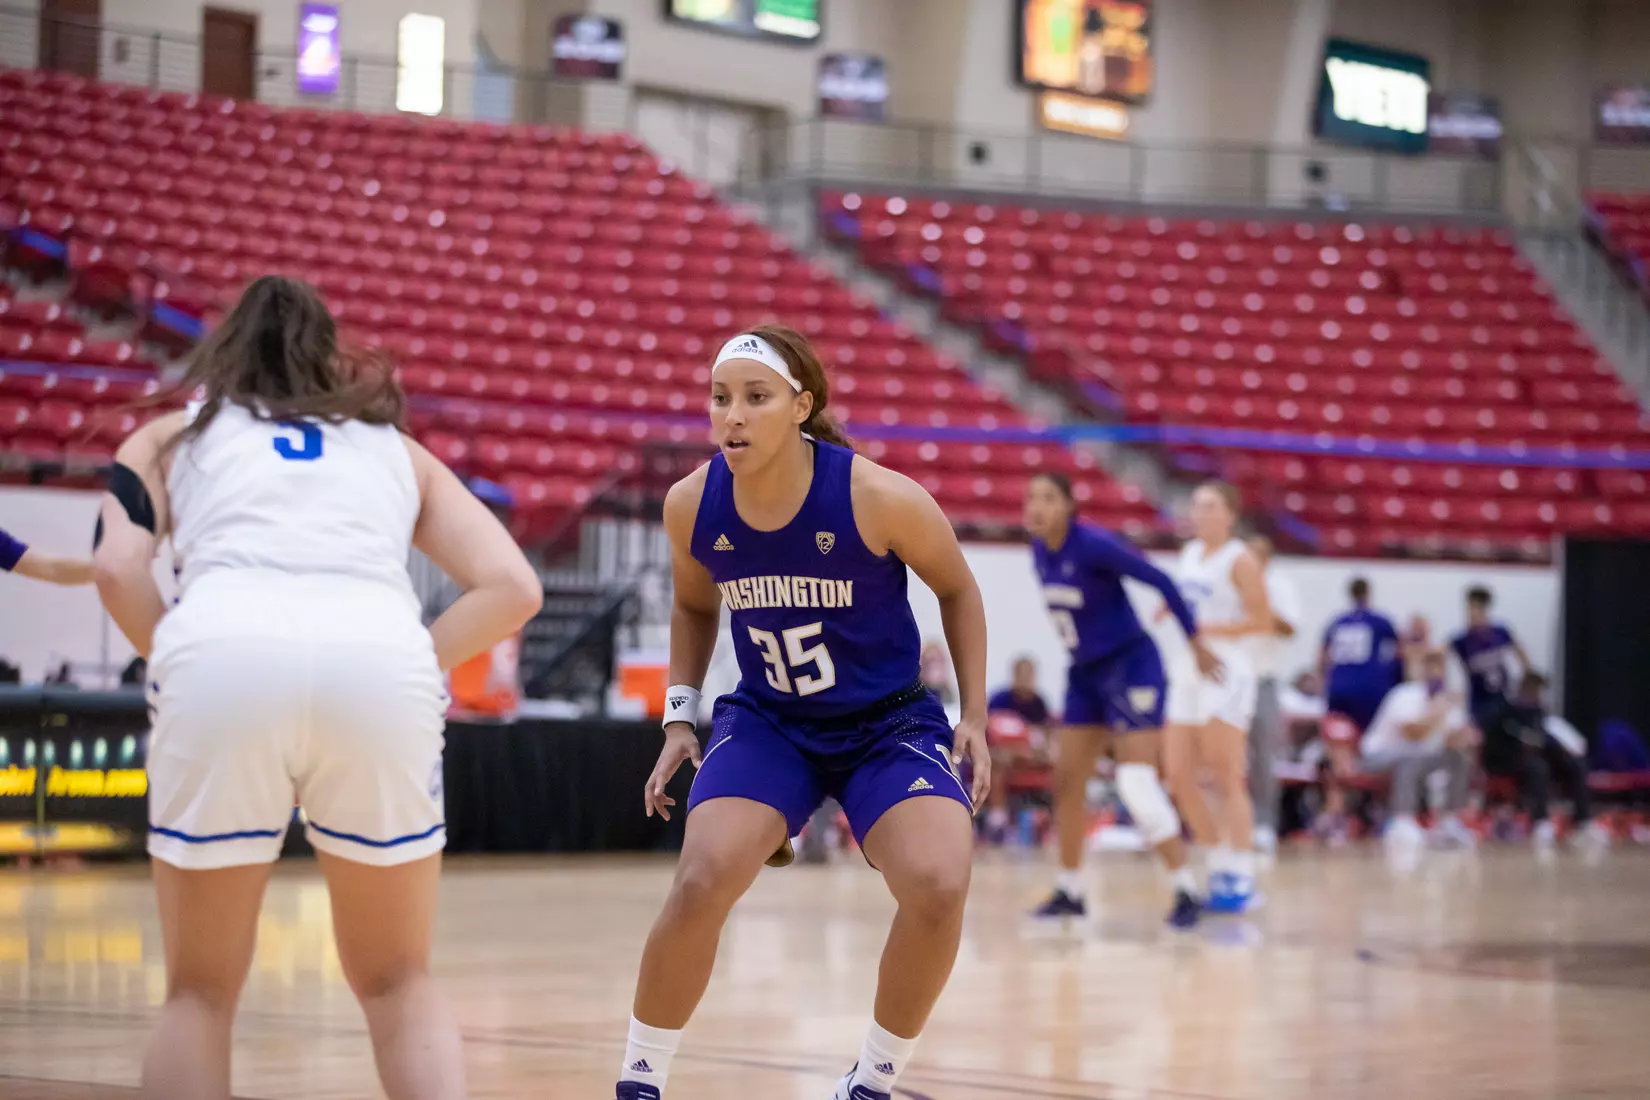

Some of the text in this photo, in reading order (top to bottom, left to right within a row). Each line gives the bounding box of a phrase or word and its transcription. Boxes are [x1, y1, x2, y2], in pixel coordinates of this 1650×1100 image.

[731, 346, 763, 355] adidas
[820, 541, 831, 550] 12
[717, 575, 853, 610] WASHINGTON
[747, 621, 836, 697] 35
[907, 784, 934, 792] adidas
[630, 1064, 653, 1073] adidas
